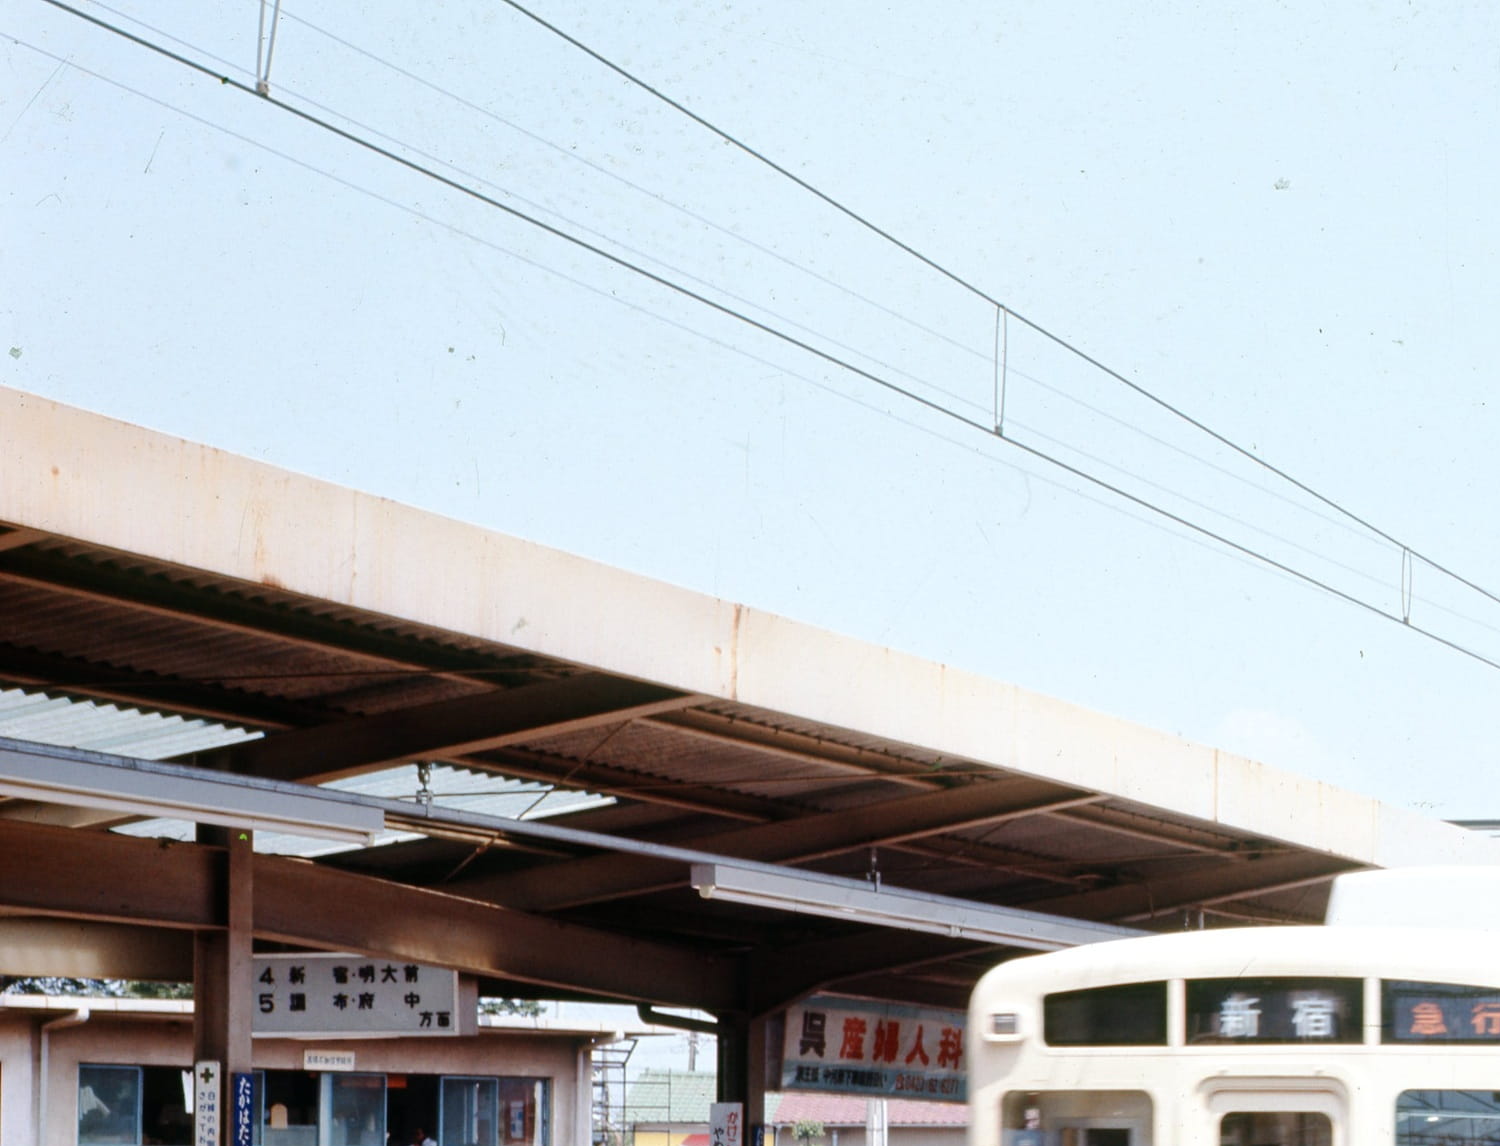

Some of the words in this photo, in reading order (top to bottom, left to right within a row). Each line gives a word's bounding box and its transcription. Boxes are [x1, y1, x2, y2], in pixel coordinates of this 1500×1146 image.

[259, 966, 275, 985] 4
[259, 993, 275, 1014] 5
[418, 1010, 451, 1027] 方面
[1218, 996, 1338, 1039] 新宿
